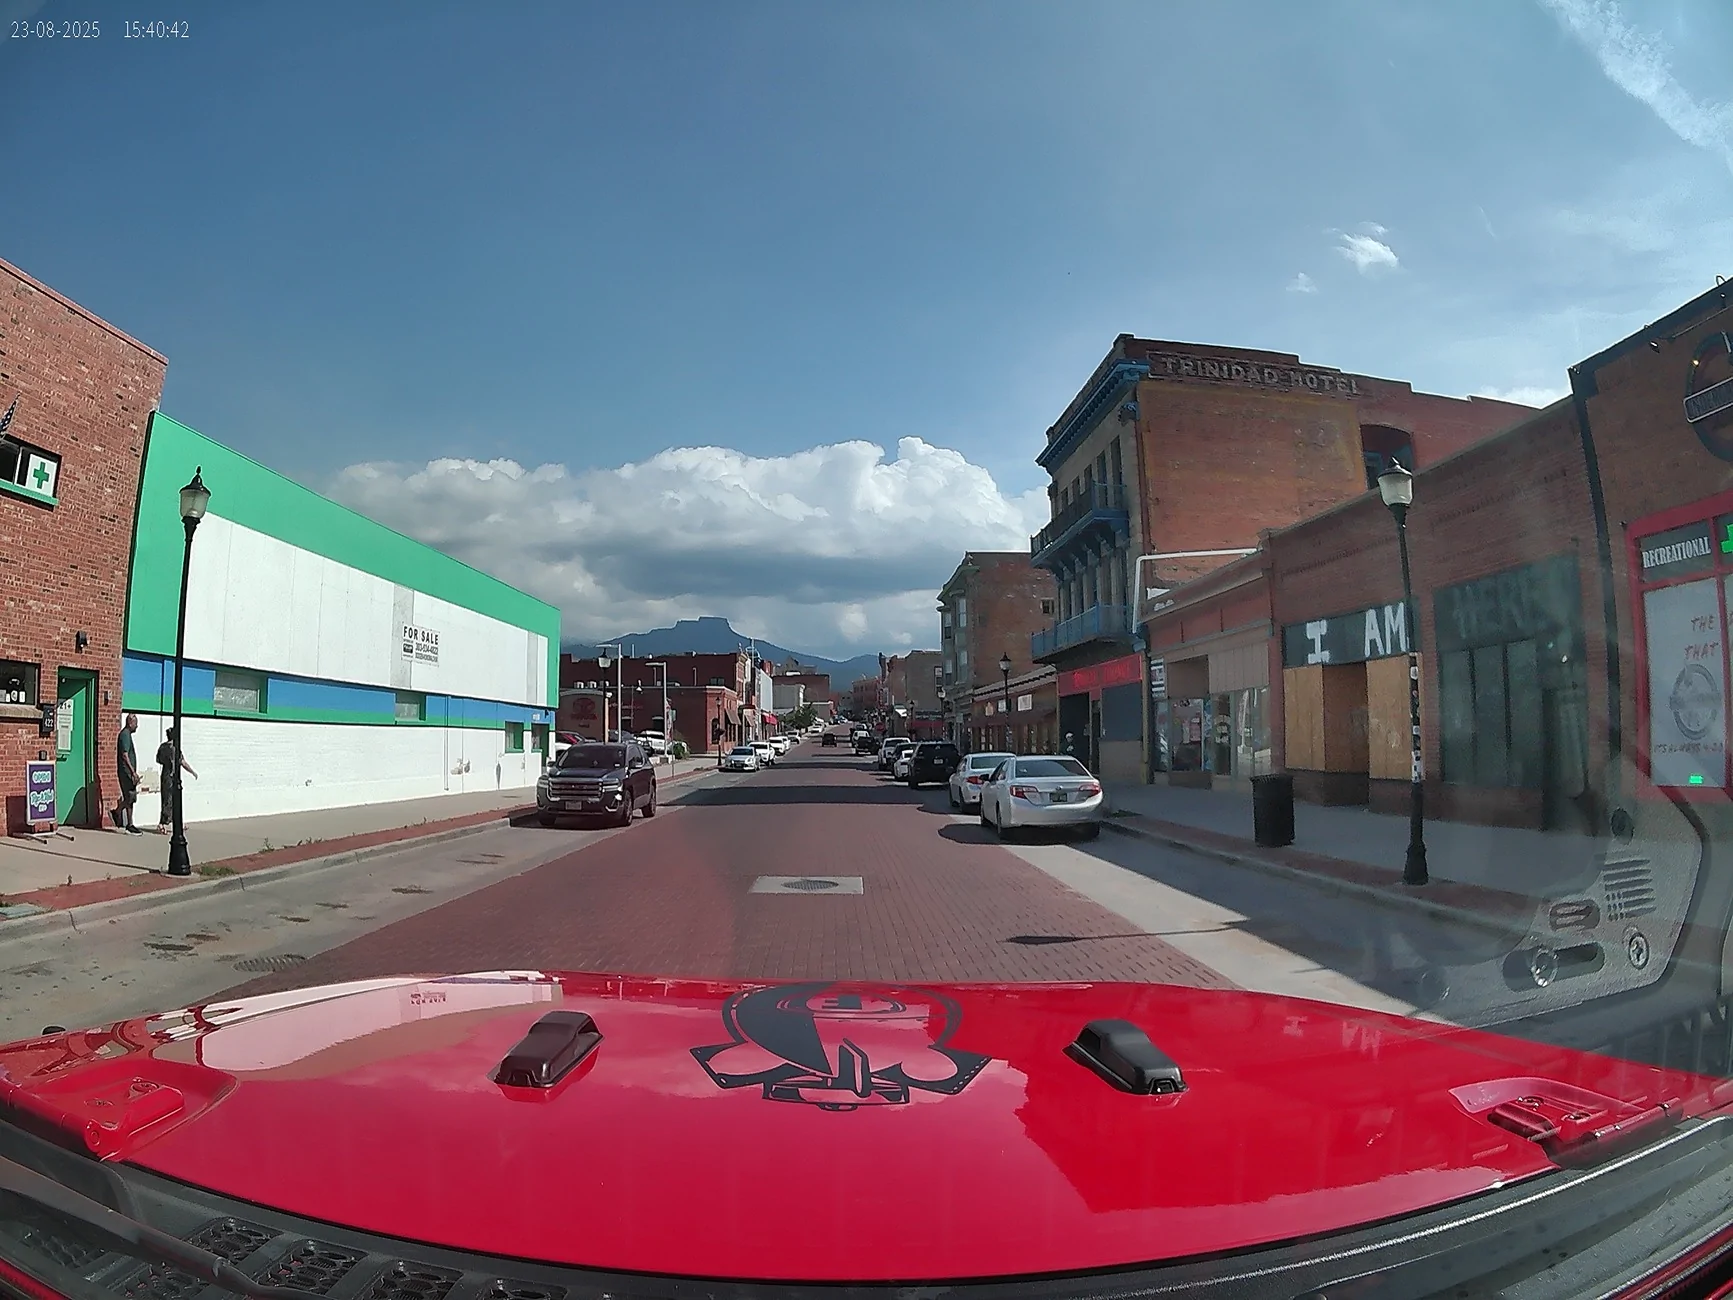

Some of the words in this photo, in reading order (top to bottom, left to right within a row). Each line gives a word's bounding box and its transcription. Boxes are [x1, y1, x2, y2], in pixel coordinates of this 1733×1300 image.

[1161, 356, 1279, 385] TRINIDAD
[1289, 371, 1360, 395] HOTEL
[1641, 536, 1712, 569] RECREATIONAL
[1305, 618, 1331, 664] I
[1364, 601, 1408, 657] AM
[1690, 614, 1715, 633] THE
[403, 626, 418, 640] FOR
[421, 631, 438, 645] SALE
[1684, 641, 1720, 660] THAT
[59, 702, 71, 710] 21+
[45, 718, 54, 727] 422
[33, 771, 51, 783] OPEN
